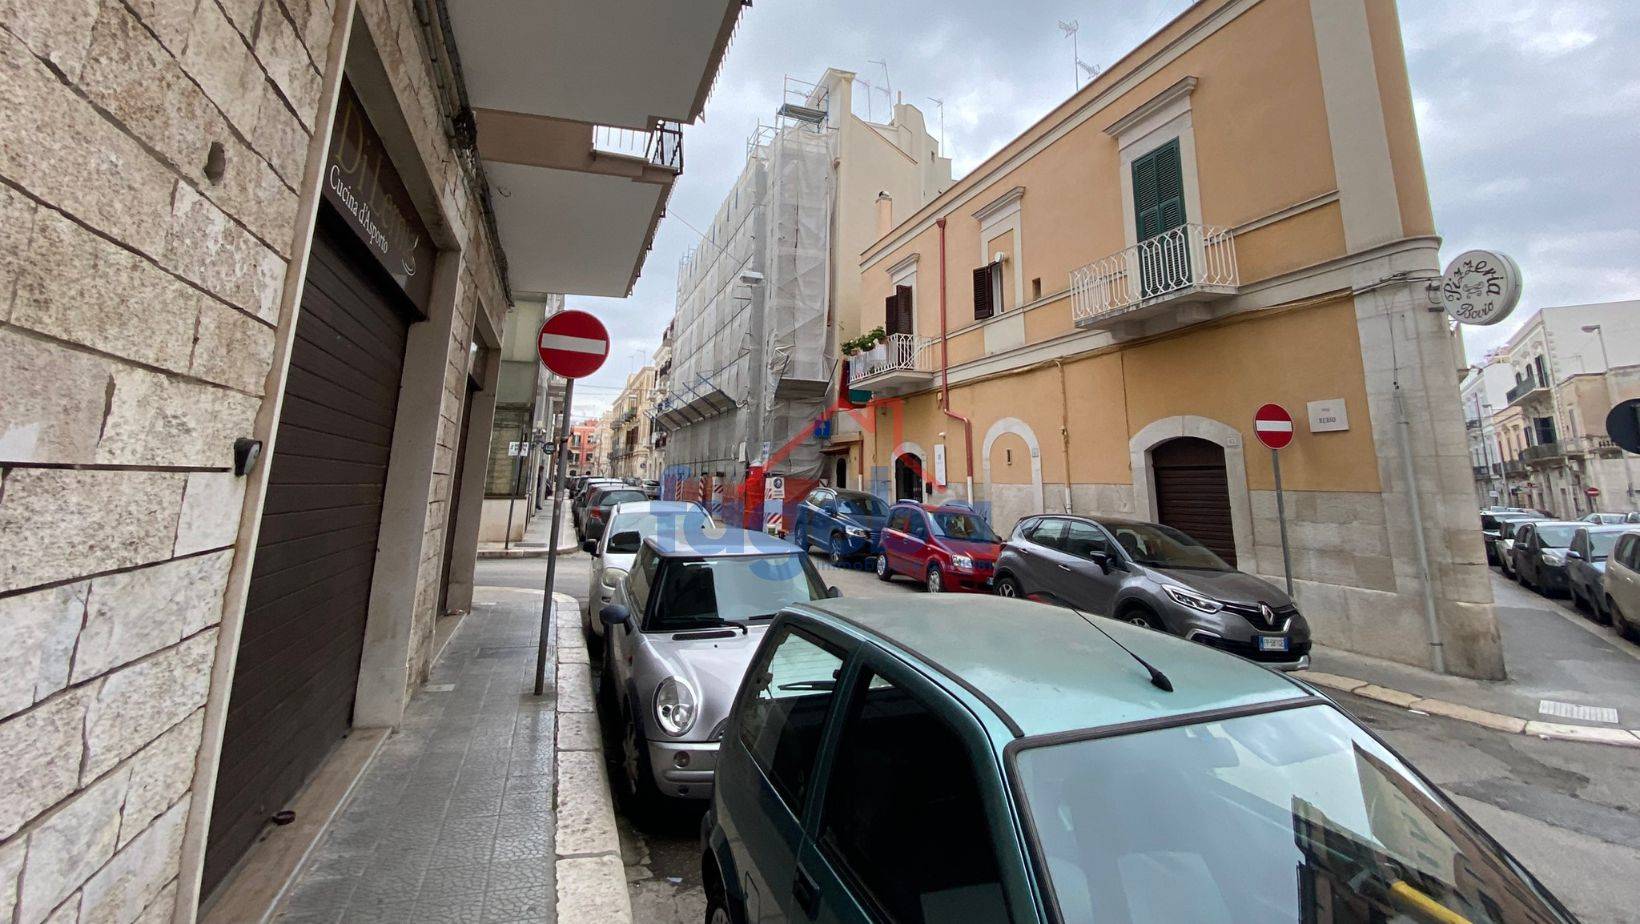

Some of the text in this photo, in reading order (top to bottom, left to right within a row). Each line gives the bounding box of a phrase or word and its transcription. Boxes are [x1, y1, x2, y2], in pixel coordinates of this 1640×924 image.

[330, 164, 389, 254] Cucina d'Asporto
[1443, 260, 1504, 302] Pizzeria
[1456, 301, 1494, 319] Bovio
